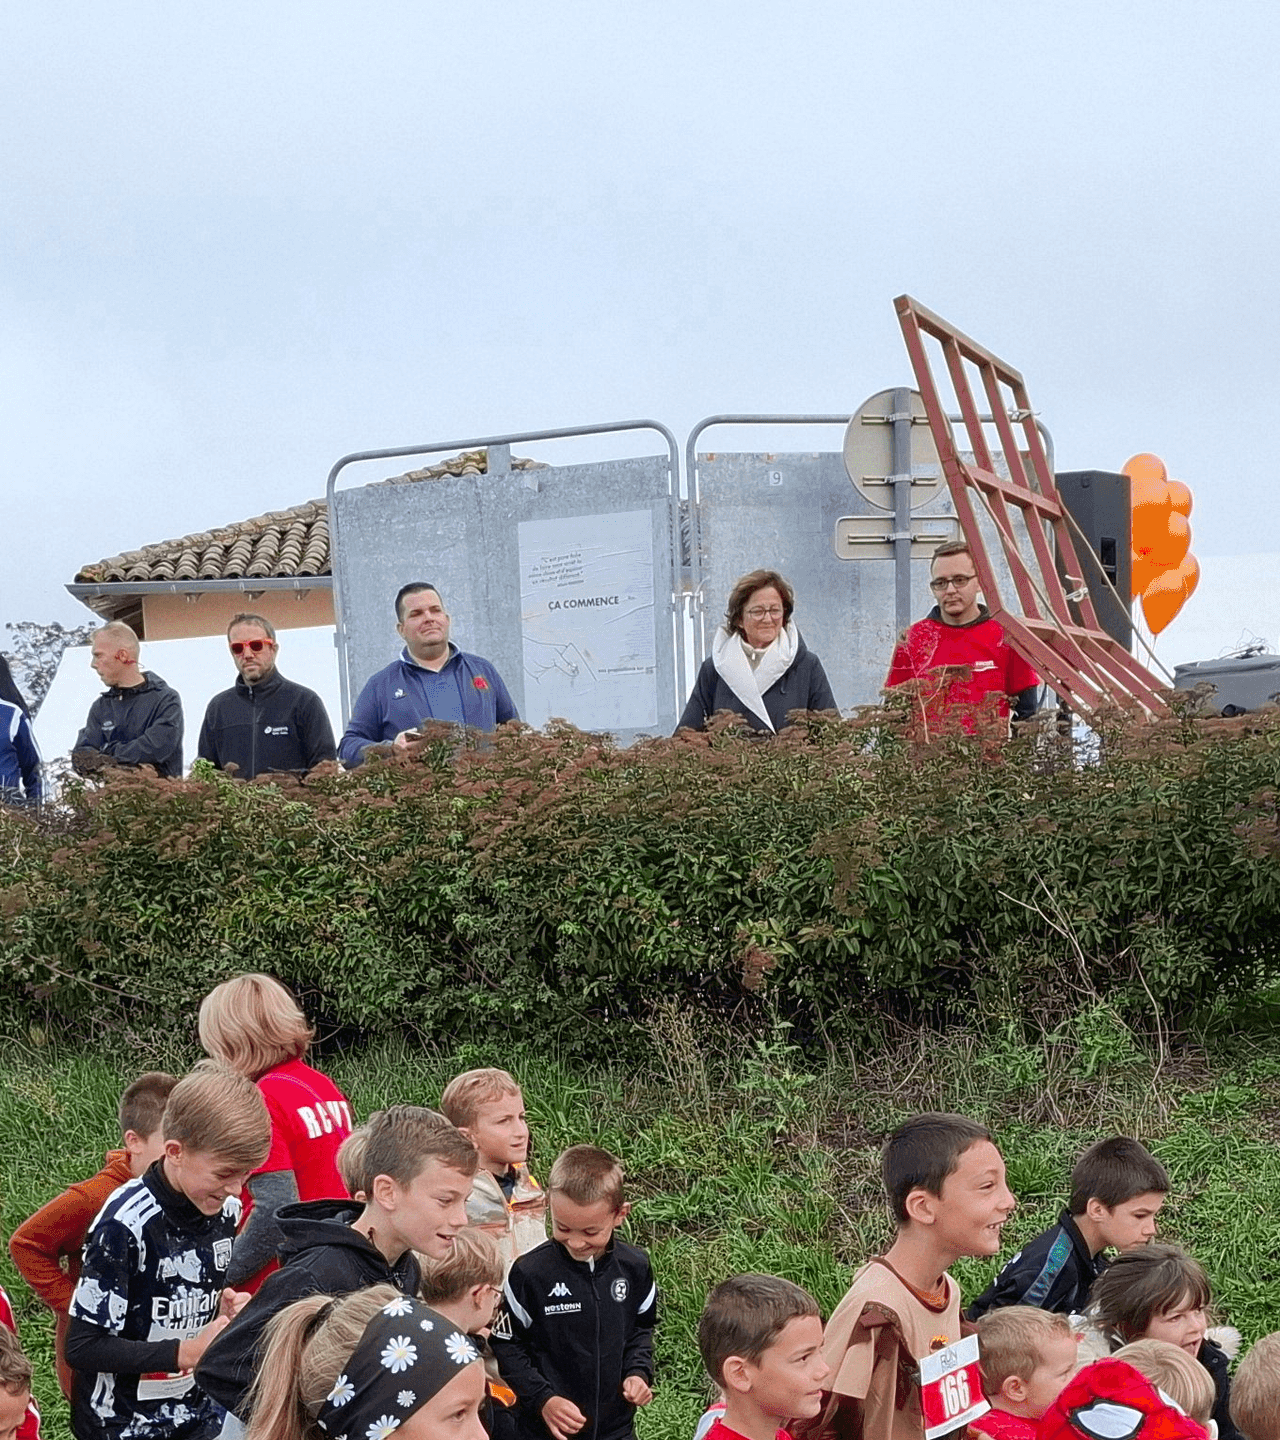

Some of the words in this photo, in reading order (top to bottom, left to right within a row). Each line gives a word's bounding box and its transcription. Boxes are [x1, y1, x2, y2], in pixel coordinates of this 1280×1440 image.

[773, 471, 781, 485] 9
[548, 601, 561, 612] ÇA
[563, 596, 619, 609] COMMENCE
[152, 1288, 222, 1320] Emirat
[940, 1369, 970, 1419] 166
